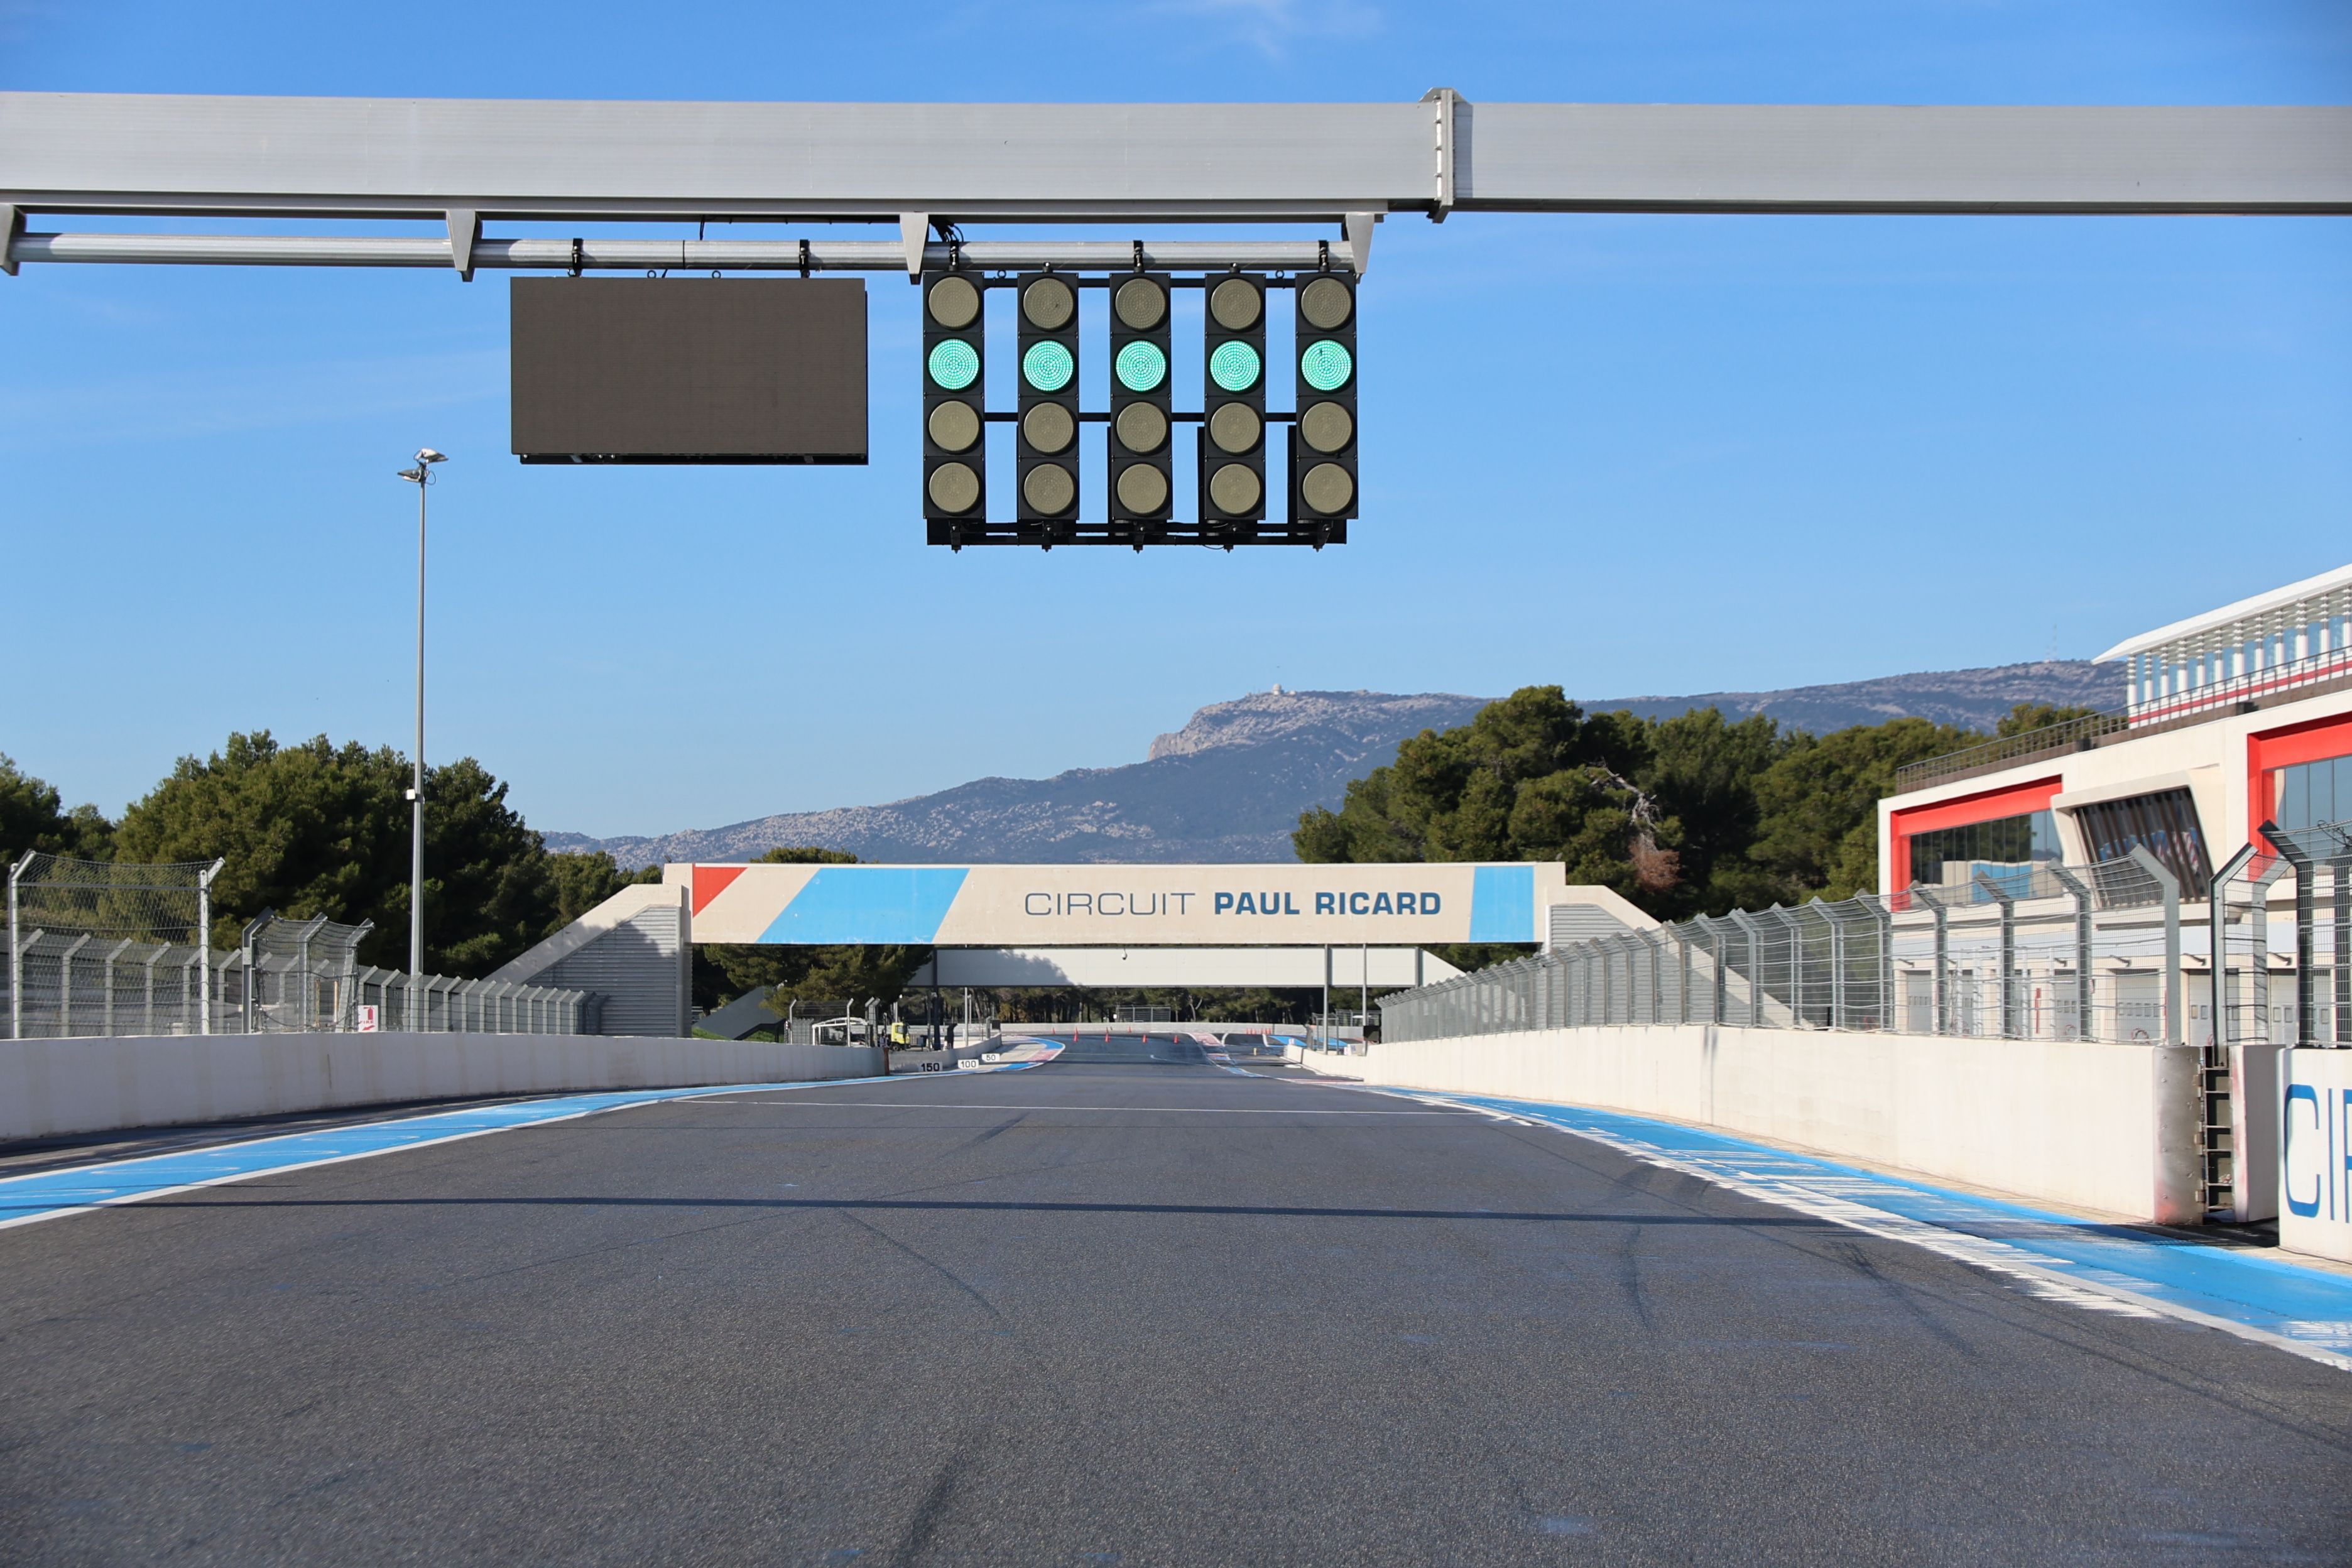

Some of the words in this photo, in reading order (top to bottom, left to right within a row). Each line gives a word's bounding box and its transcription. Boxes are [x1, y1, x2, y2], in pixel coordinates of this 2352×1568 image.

[1025, 893, 1195, 915] CIRCUIT
[1214, 892, 1300, 915] PAUL
[1315, 892, 1441, 915] RICARD
[921, 1063, 940, 1072] 150
